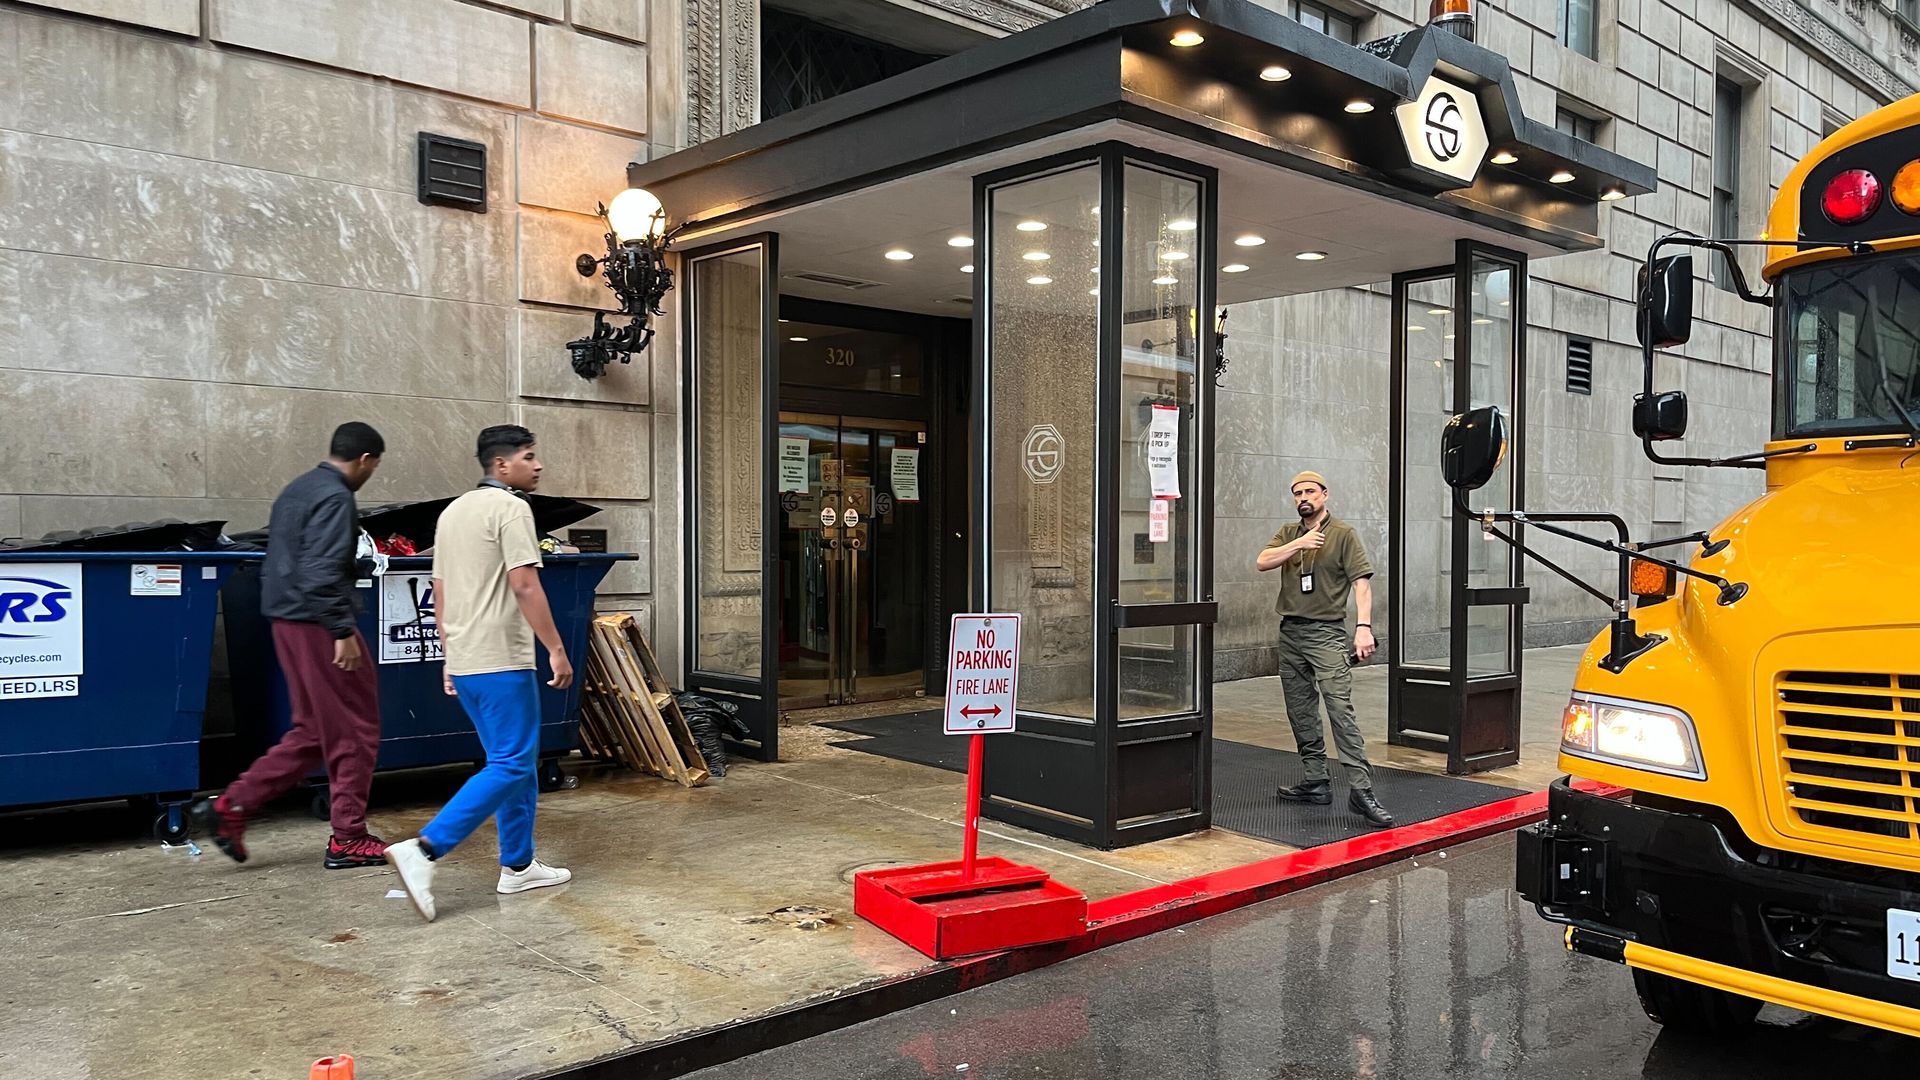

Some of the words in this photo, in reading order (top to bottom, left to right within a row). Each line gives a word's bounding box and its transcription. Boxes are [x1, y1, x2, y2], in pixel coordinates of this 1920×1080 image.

[825, 347, 855, 367] 320
[0, 591, 72, 623] RS
[397, 626, 440, 639] LRSrec
[976, 629, 995, 649] NO
[404, 644, 443, 655] 844.N
[0, 653, 62, 665] ecycles.com
[956, 650, 1012, 670] PARKING
[1, 680, 76, 694] EED.LRS
[956, 679, 980, 695] FIRE
[982, 678, 1009, 695] LANE
